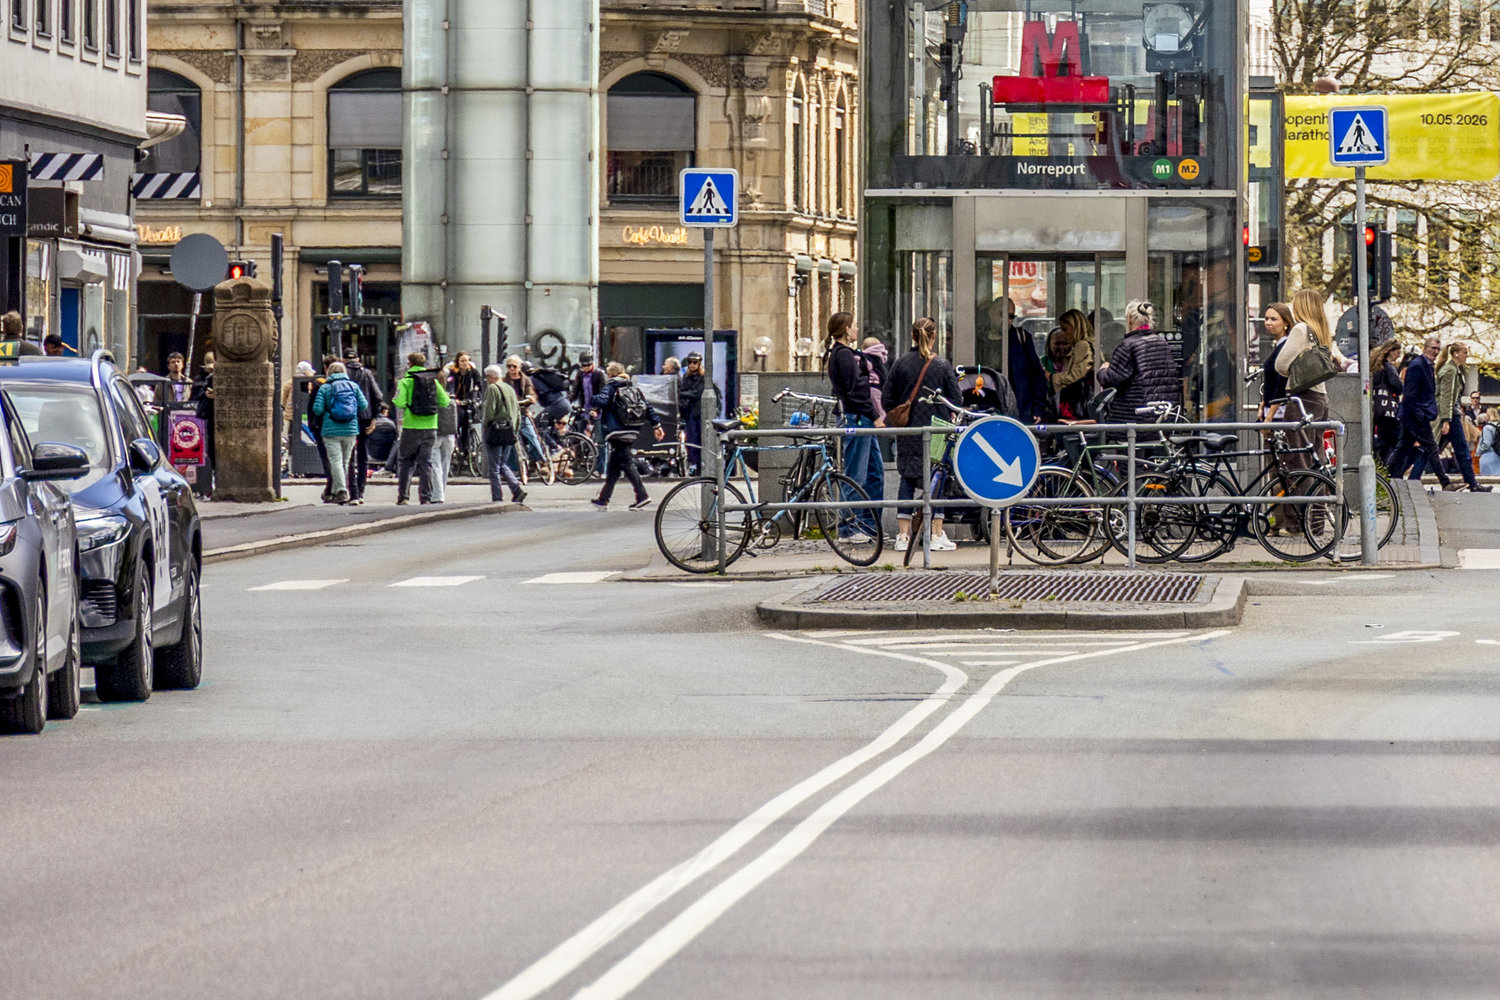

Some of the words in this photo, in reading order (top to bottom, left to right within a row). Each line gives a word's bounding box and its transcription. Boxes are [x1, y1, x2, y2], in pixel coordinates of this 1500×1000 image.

[1285, 112, 1328, 127] openh
[1421, 113, 1488, 126] 10.05.2026
[1285, 129, 1331, 141] aratho
[1017, 162, 1086, 179] Nørreport
[1156, 164, 1170, 174] M1
[1181, 164, 1197, 174] M2
